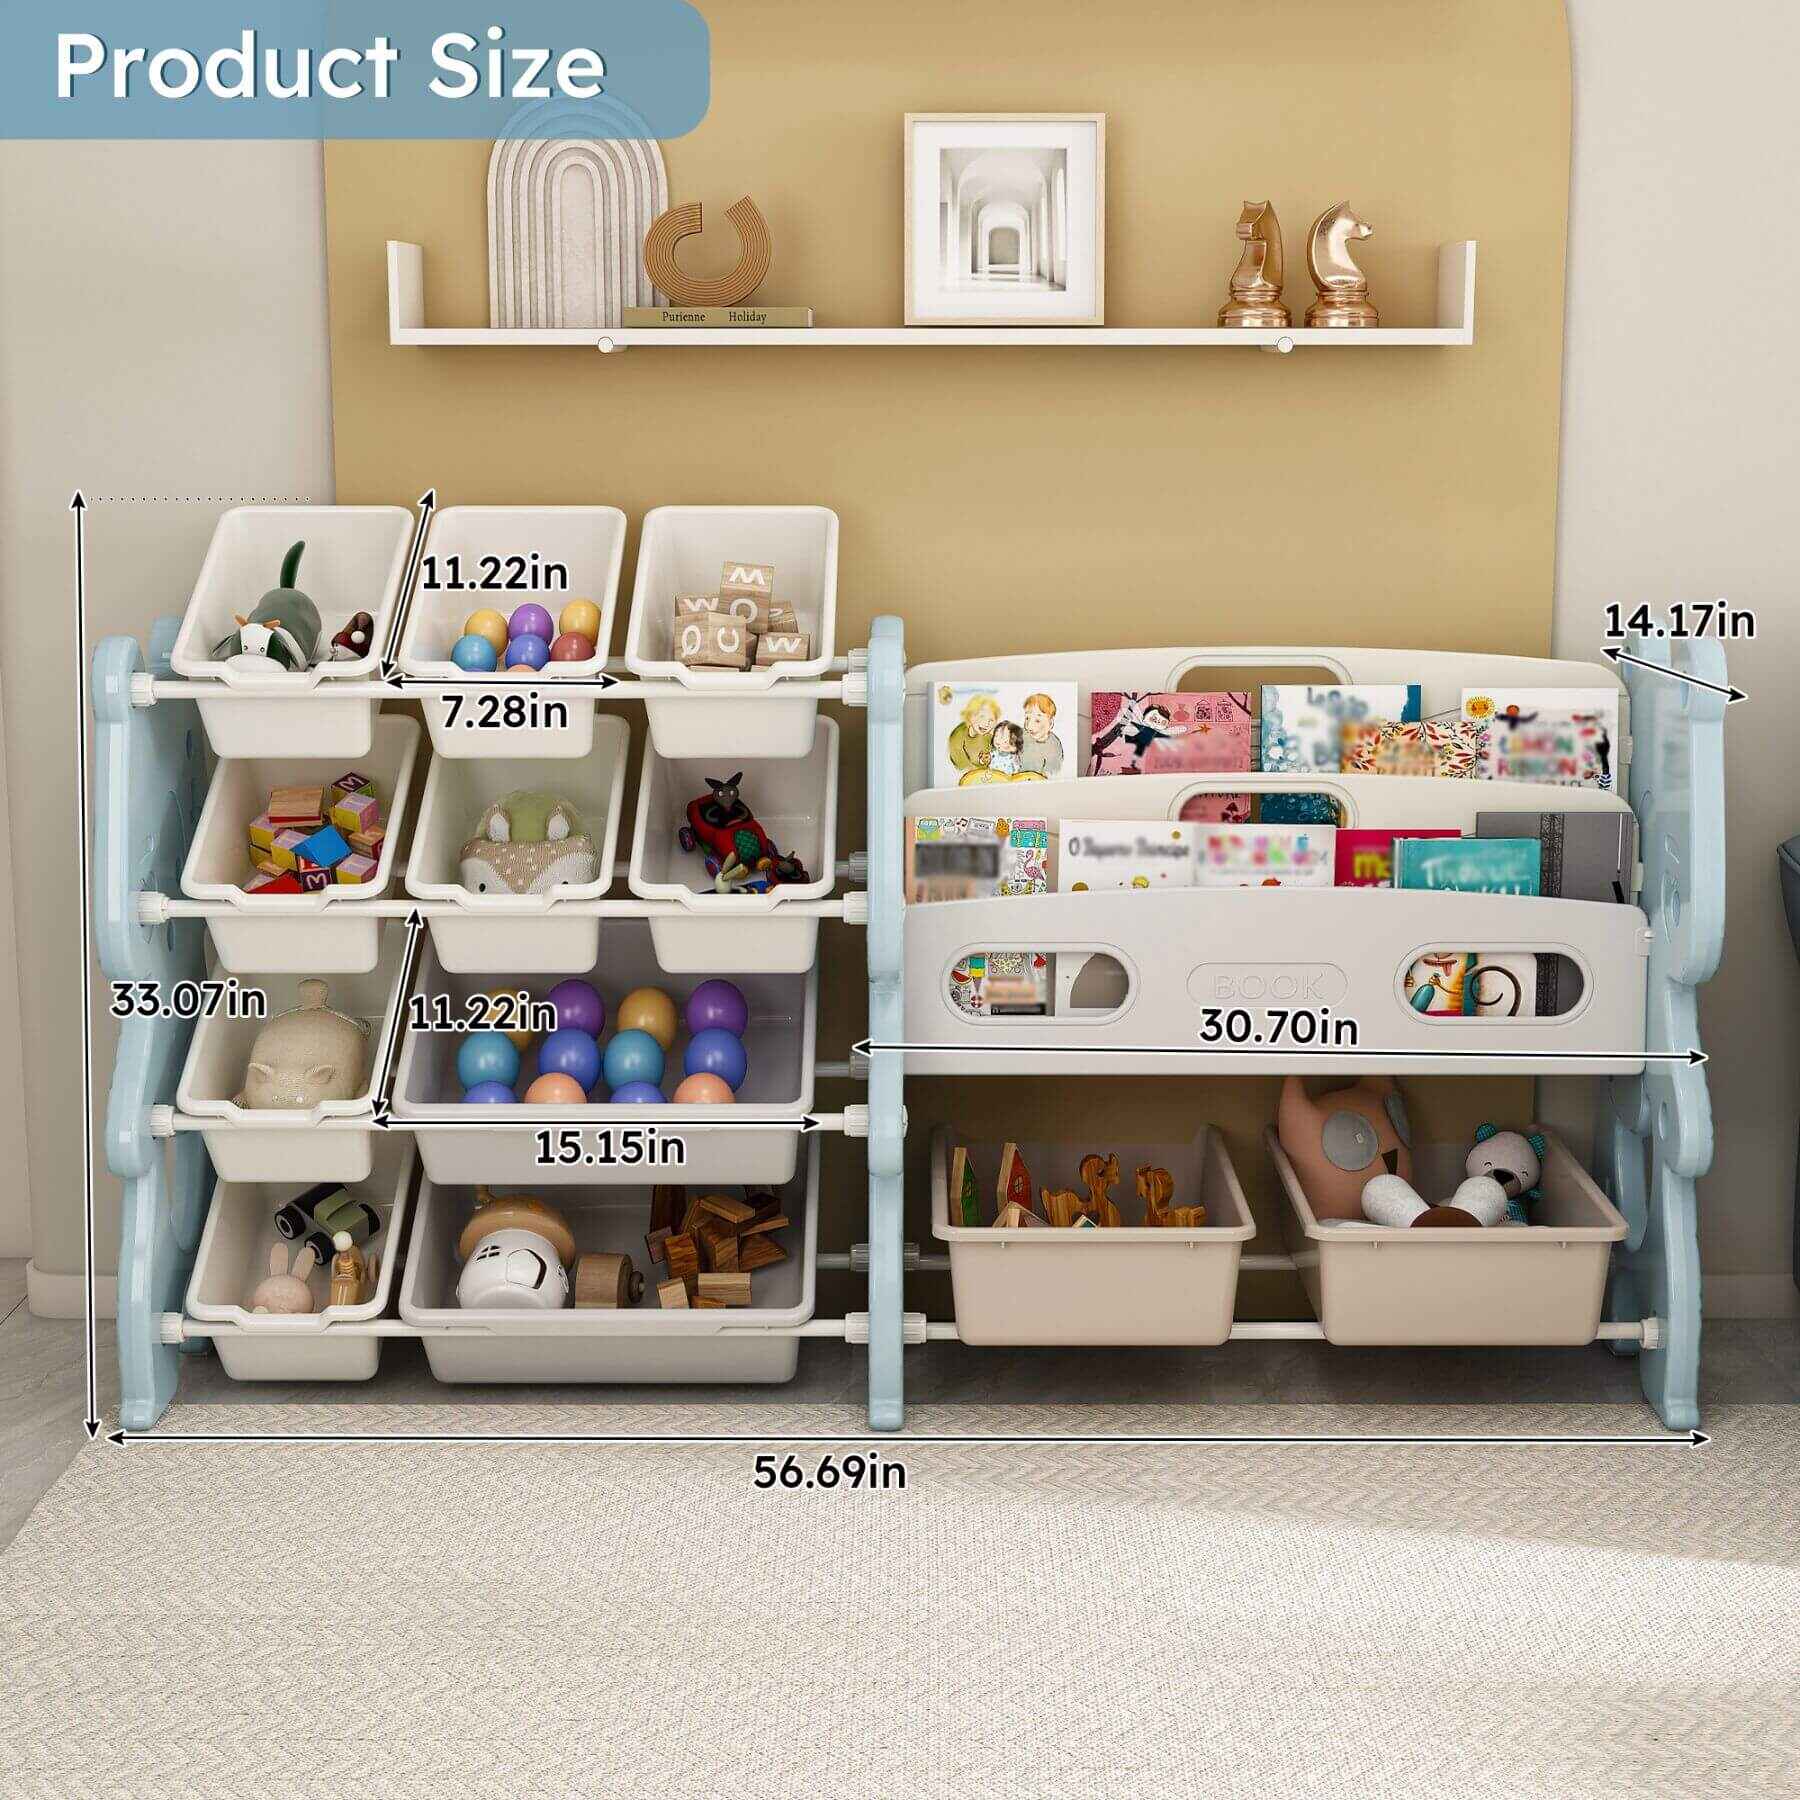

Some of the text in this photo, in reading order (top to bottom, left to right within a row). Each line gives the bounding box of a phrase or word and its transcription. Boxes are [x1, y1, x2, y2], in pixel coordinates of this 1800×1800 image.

[662, 311, 767, 324] Purienne Holiday
[1213, 974, 1326, 1000] BOOK
